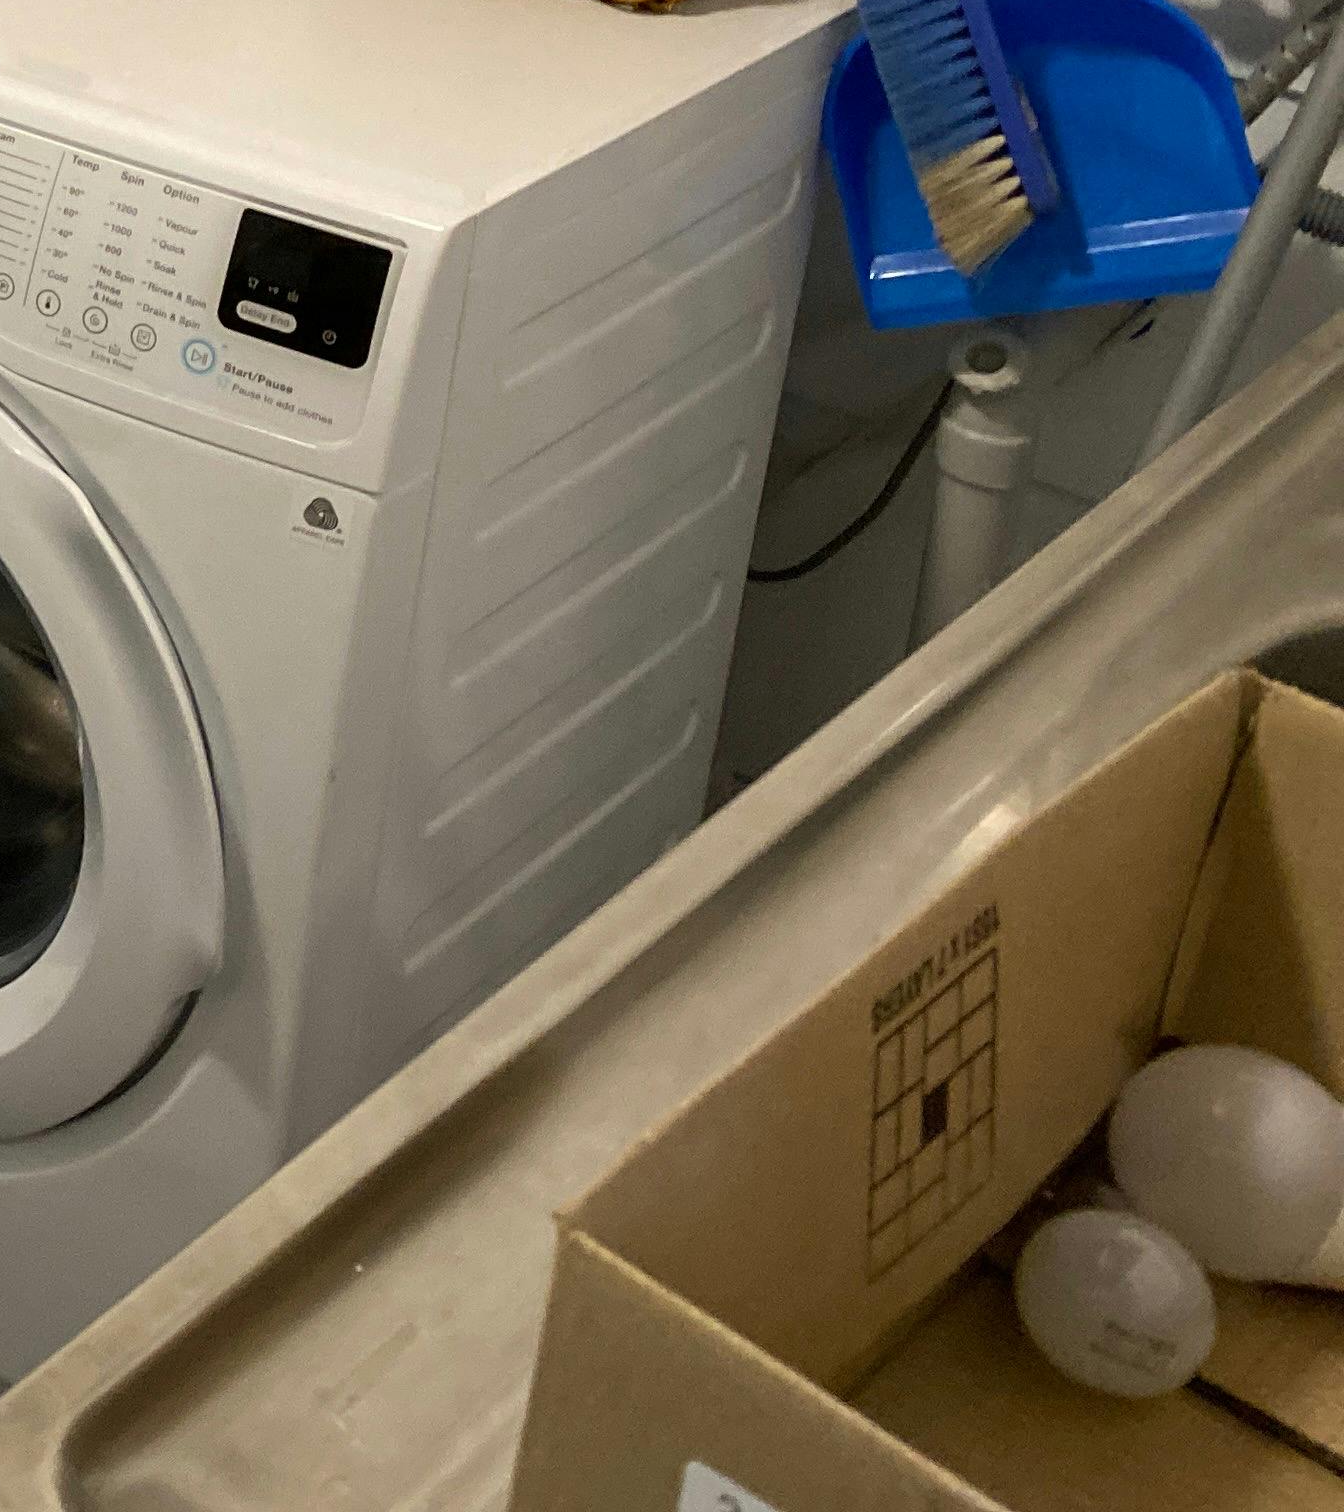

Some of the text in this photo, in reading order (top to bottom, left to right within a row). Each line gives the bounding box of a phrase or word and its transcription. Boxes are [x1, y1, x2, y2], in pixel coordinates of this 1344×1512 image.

[72, 154, 100, 172] Temp
[121, 170, 145, 186] Spin
[163, 185, 200, 204] Option
[165, 219, 199, 236] Vapour
[159, 240, 186, 256] Quick
[47, 269, 68, 283] Cold
[99, 265, 135, 285] No Spin
[154, 260, 177, 276] Soak
[148, 281, 174, 298] Rinse
[185, 295, 207, 310] Spin
[142, 303, 168, 319] Drain
[179, 315, 201, 330] Spin
[223, 362, 294, 395] Start/Pause
[231, 383, 261, 400] Pause
